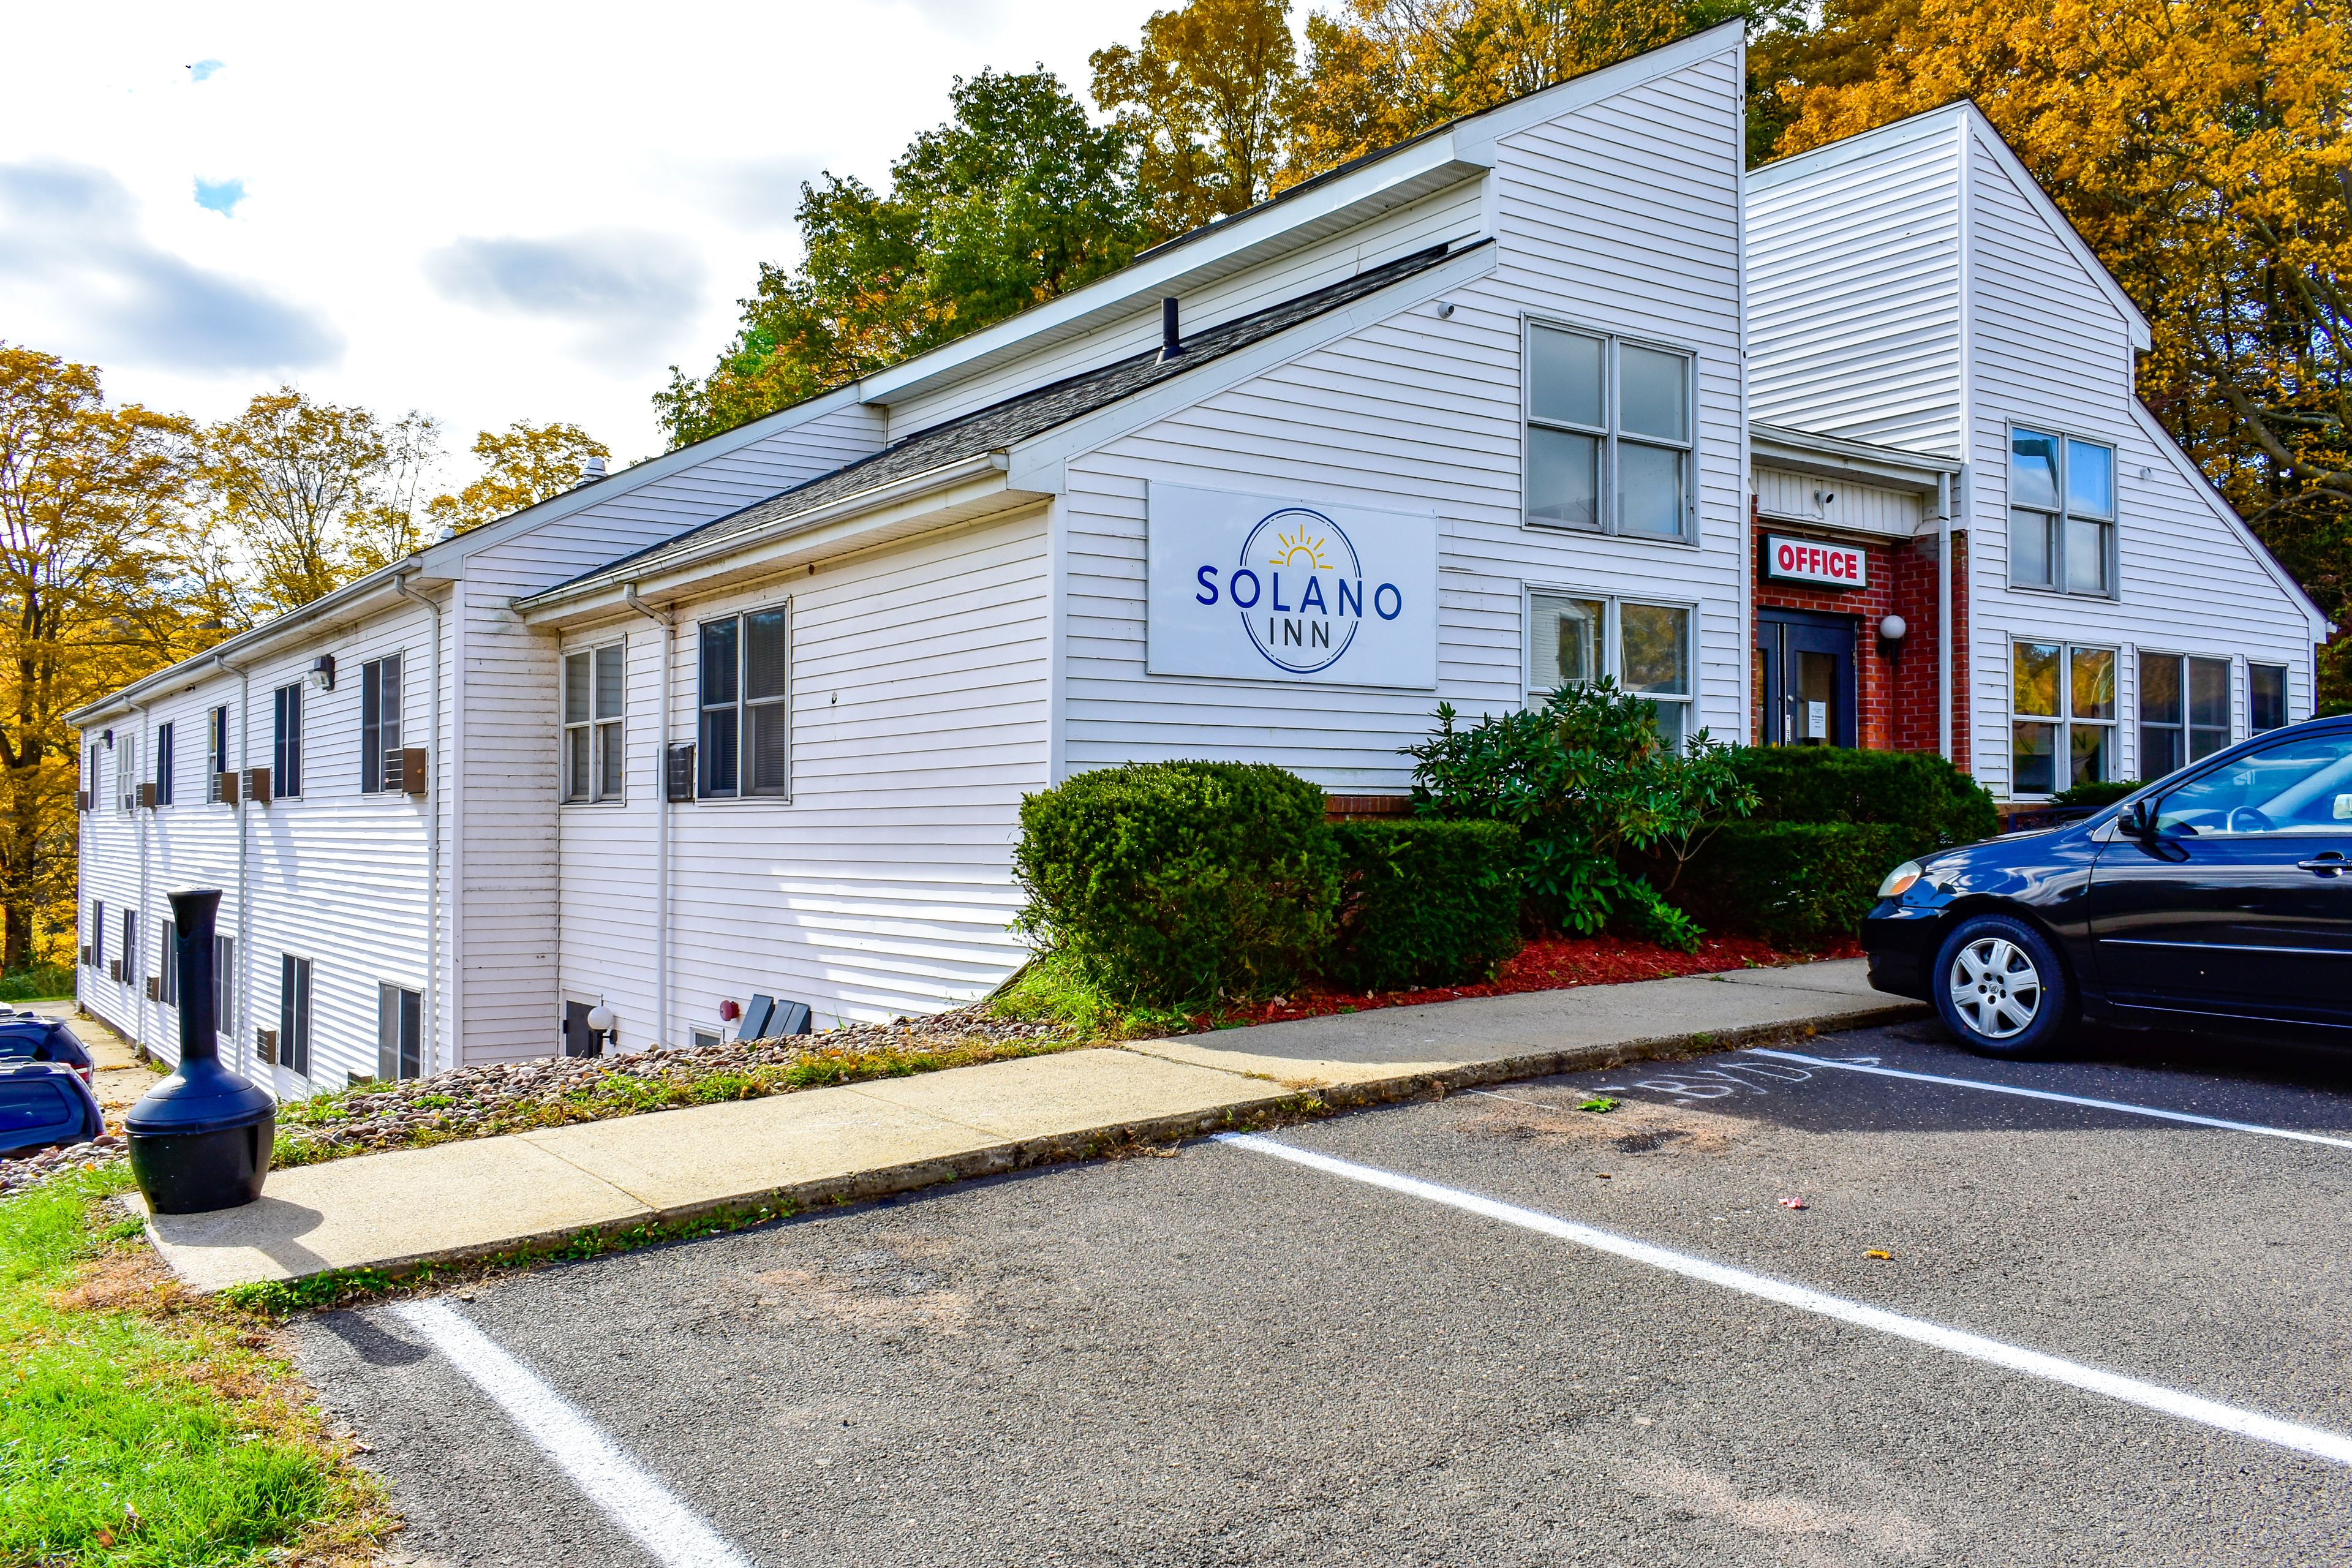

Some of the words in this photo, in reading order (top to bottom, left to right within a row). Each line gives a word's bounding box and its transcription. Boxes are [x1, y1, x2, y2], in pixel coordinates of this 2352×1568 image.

[1777, 545, 1857, 579] OFFICE
[1195, 565, 1402, 620] SOLANO
[1270, 617, 1329, 649] INN
